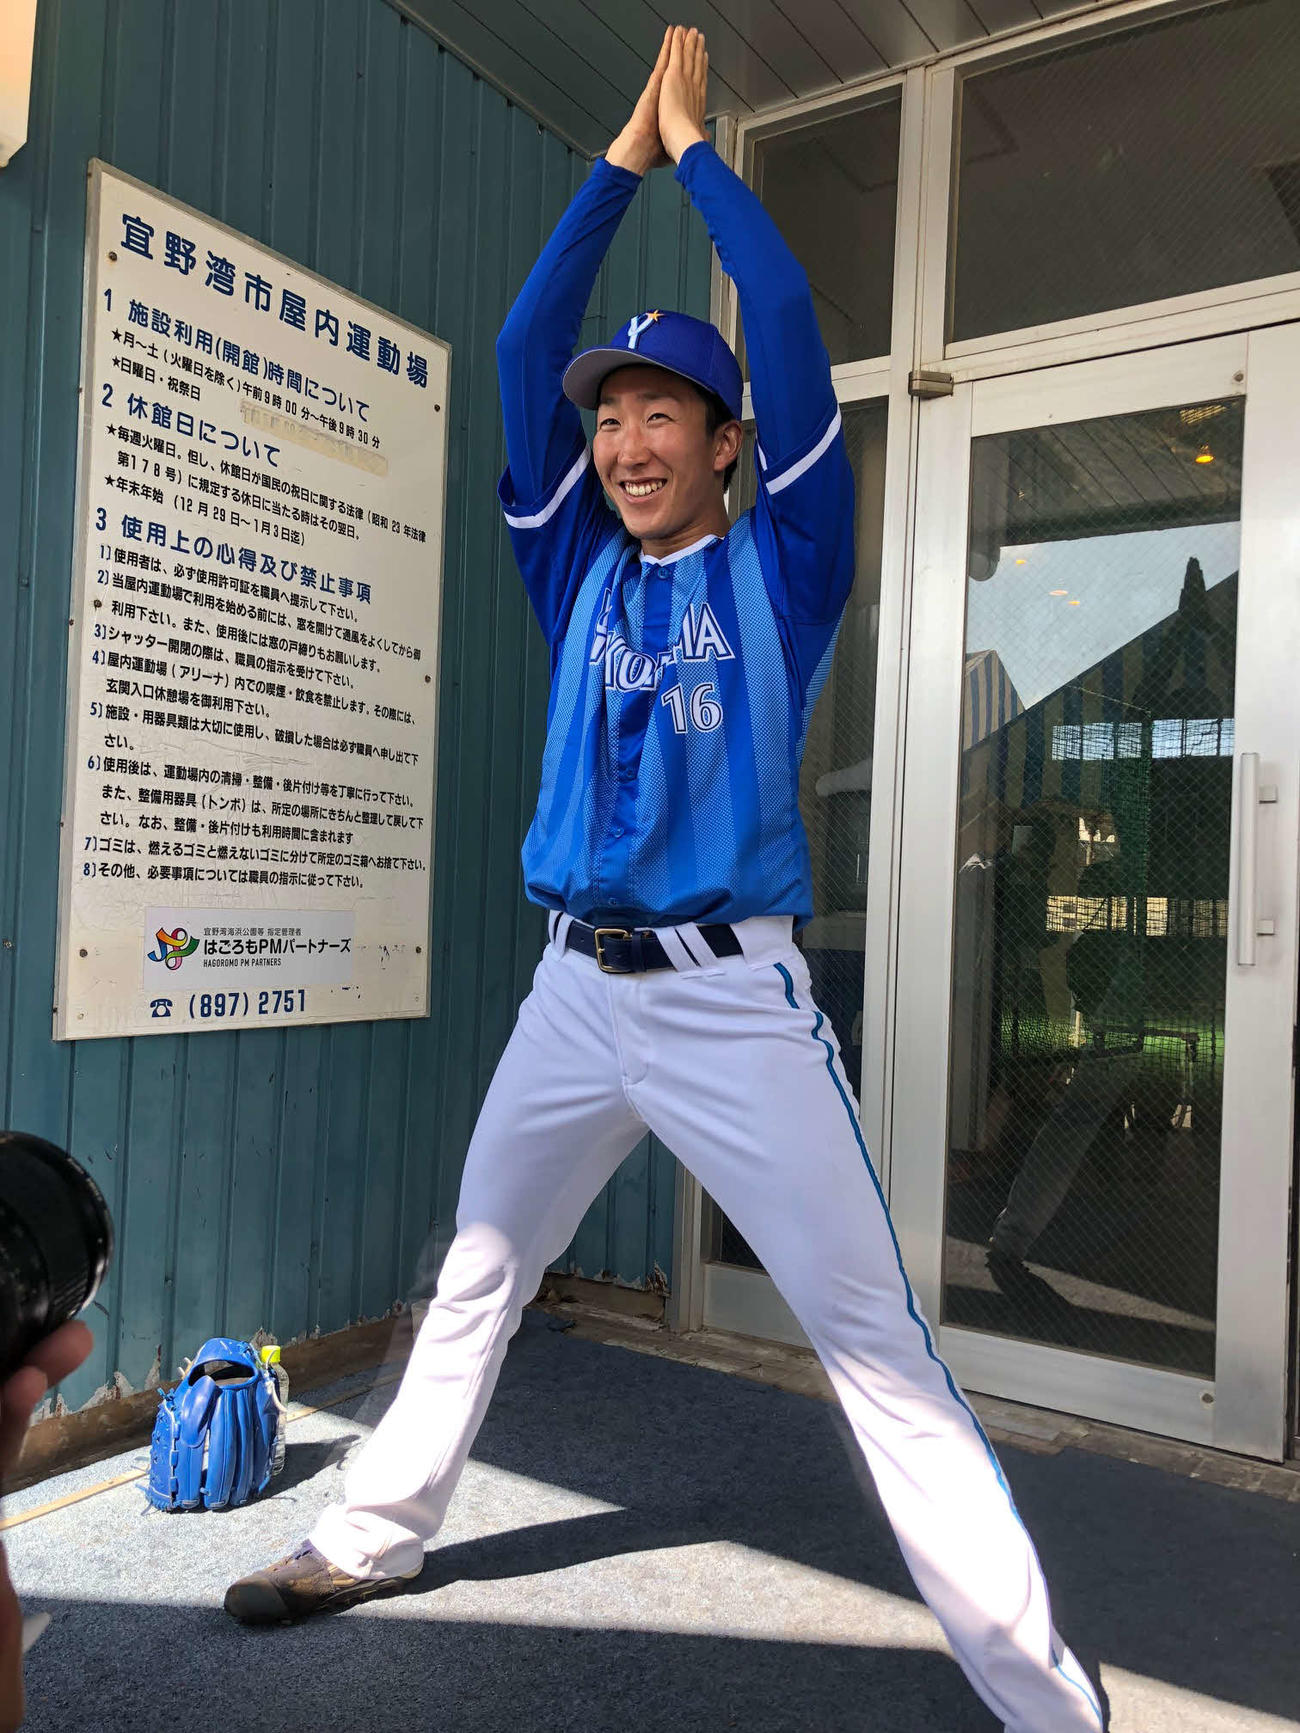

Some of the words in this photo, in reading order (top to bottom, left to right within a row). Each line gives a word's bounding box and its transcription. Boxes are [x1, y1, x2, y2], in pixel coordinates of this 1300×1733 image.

[120, 213, 428, 389] 宜野湾市屋内運動場
[127, 393, 281, 467] 休館日について
[121, 514, 372, 604] 使用上の心得及び禁止事項
[660, 681, 724, 734] 16
[104, 733, 135, 751] さい。
[203, 938, 352, 956] はごろもPMパートナーズ
[203, 958, 239, 968] HAGOROMO
[240, 958, 250, 967] PM
[251, 957, 282, 967] PARTNERS
